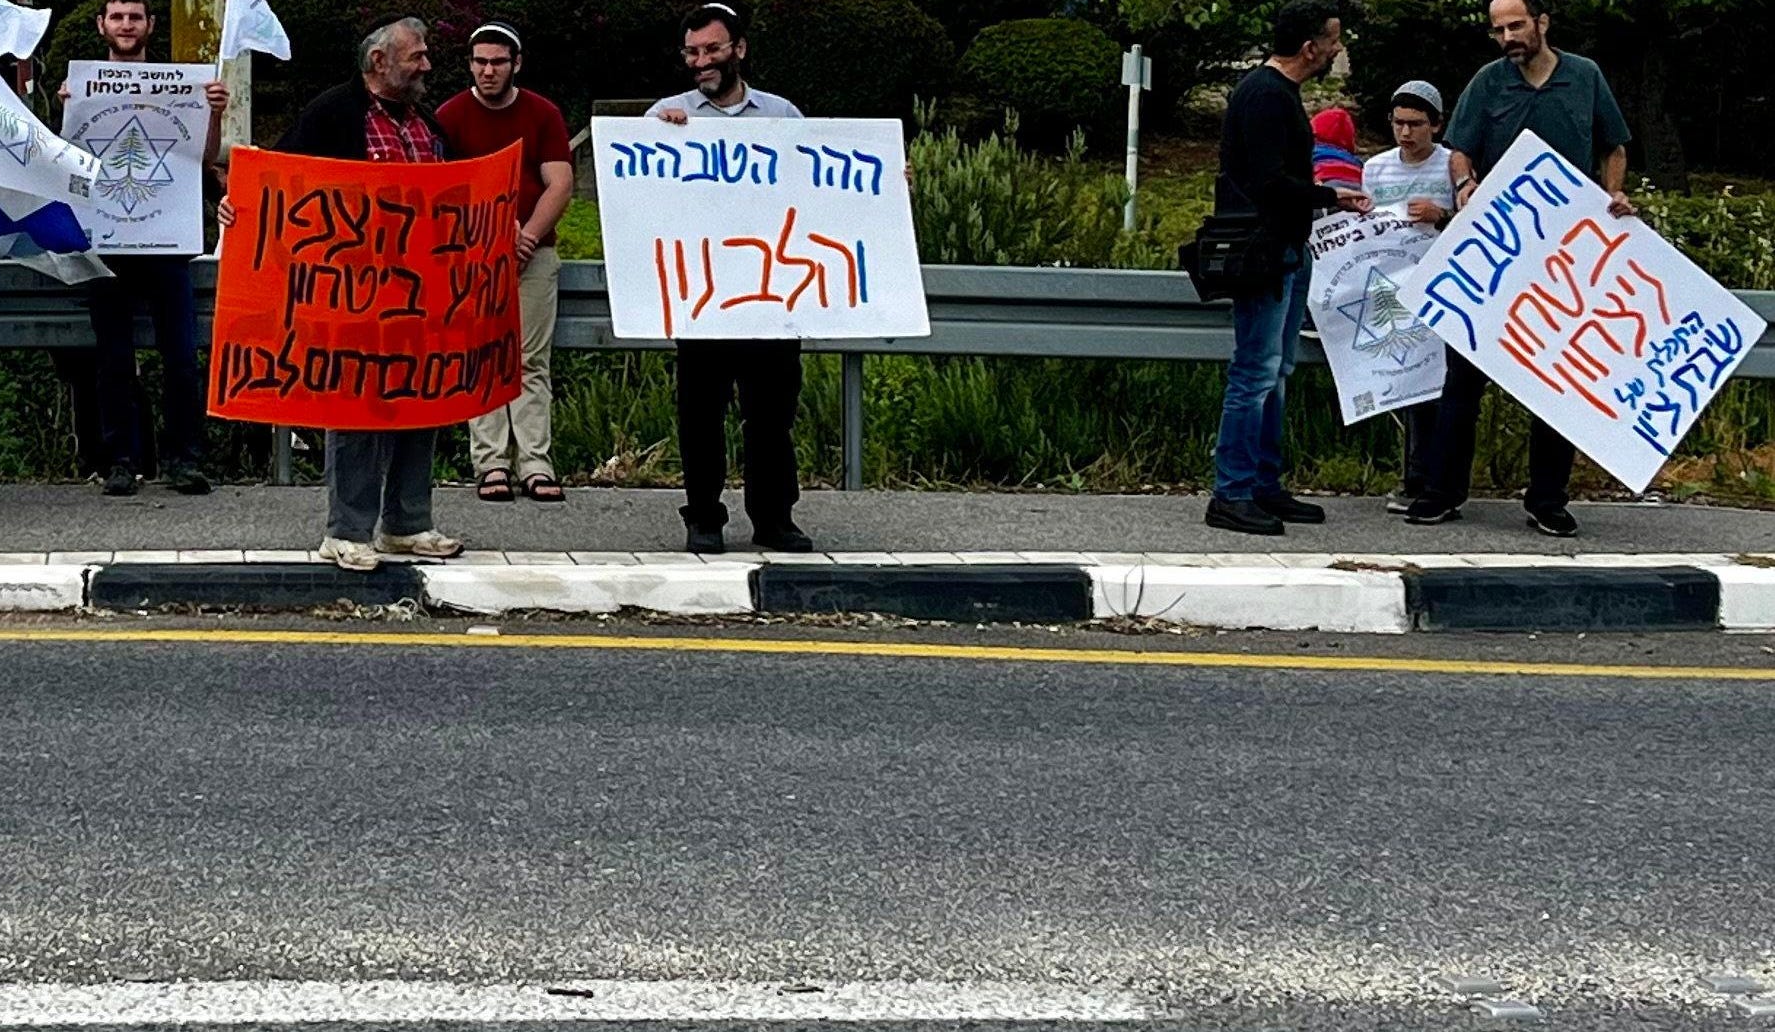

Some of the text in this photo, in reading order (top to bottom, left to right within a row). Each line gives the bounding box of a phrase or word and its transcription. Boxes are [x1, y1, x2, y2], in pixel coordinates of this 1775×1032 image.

[86, 80, 193, 98] מגיע ביטחון
[98, 68, 184, 81] לתושבי הצפון
[795, 143, 884, 196] ההר
[253, 184, 417, 272] הצפון
[1309, 229, 1366, 261] ביטחון
[283, 261, 428, 332] ביטחון
[654, 205, 868, 340] והלבנון
[1497, 217, 1630, 395] ביטחון
[216, 328, 300, 407] לבנון
[1551, 258, 1671, 420] ניצחון
[1613, 377, 1645, 410] של
[1631, 317, 1743, 457] שיבת ציון
